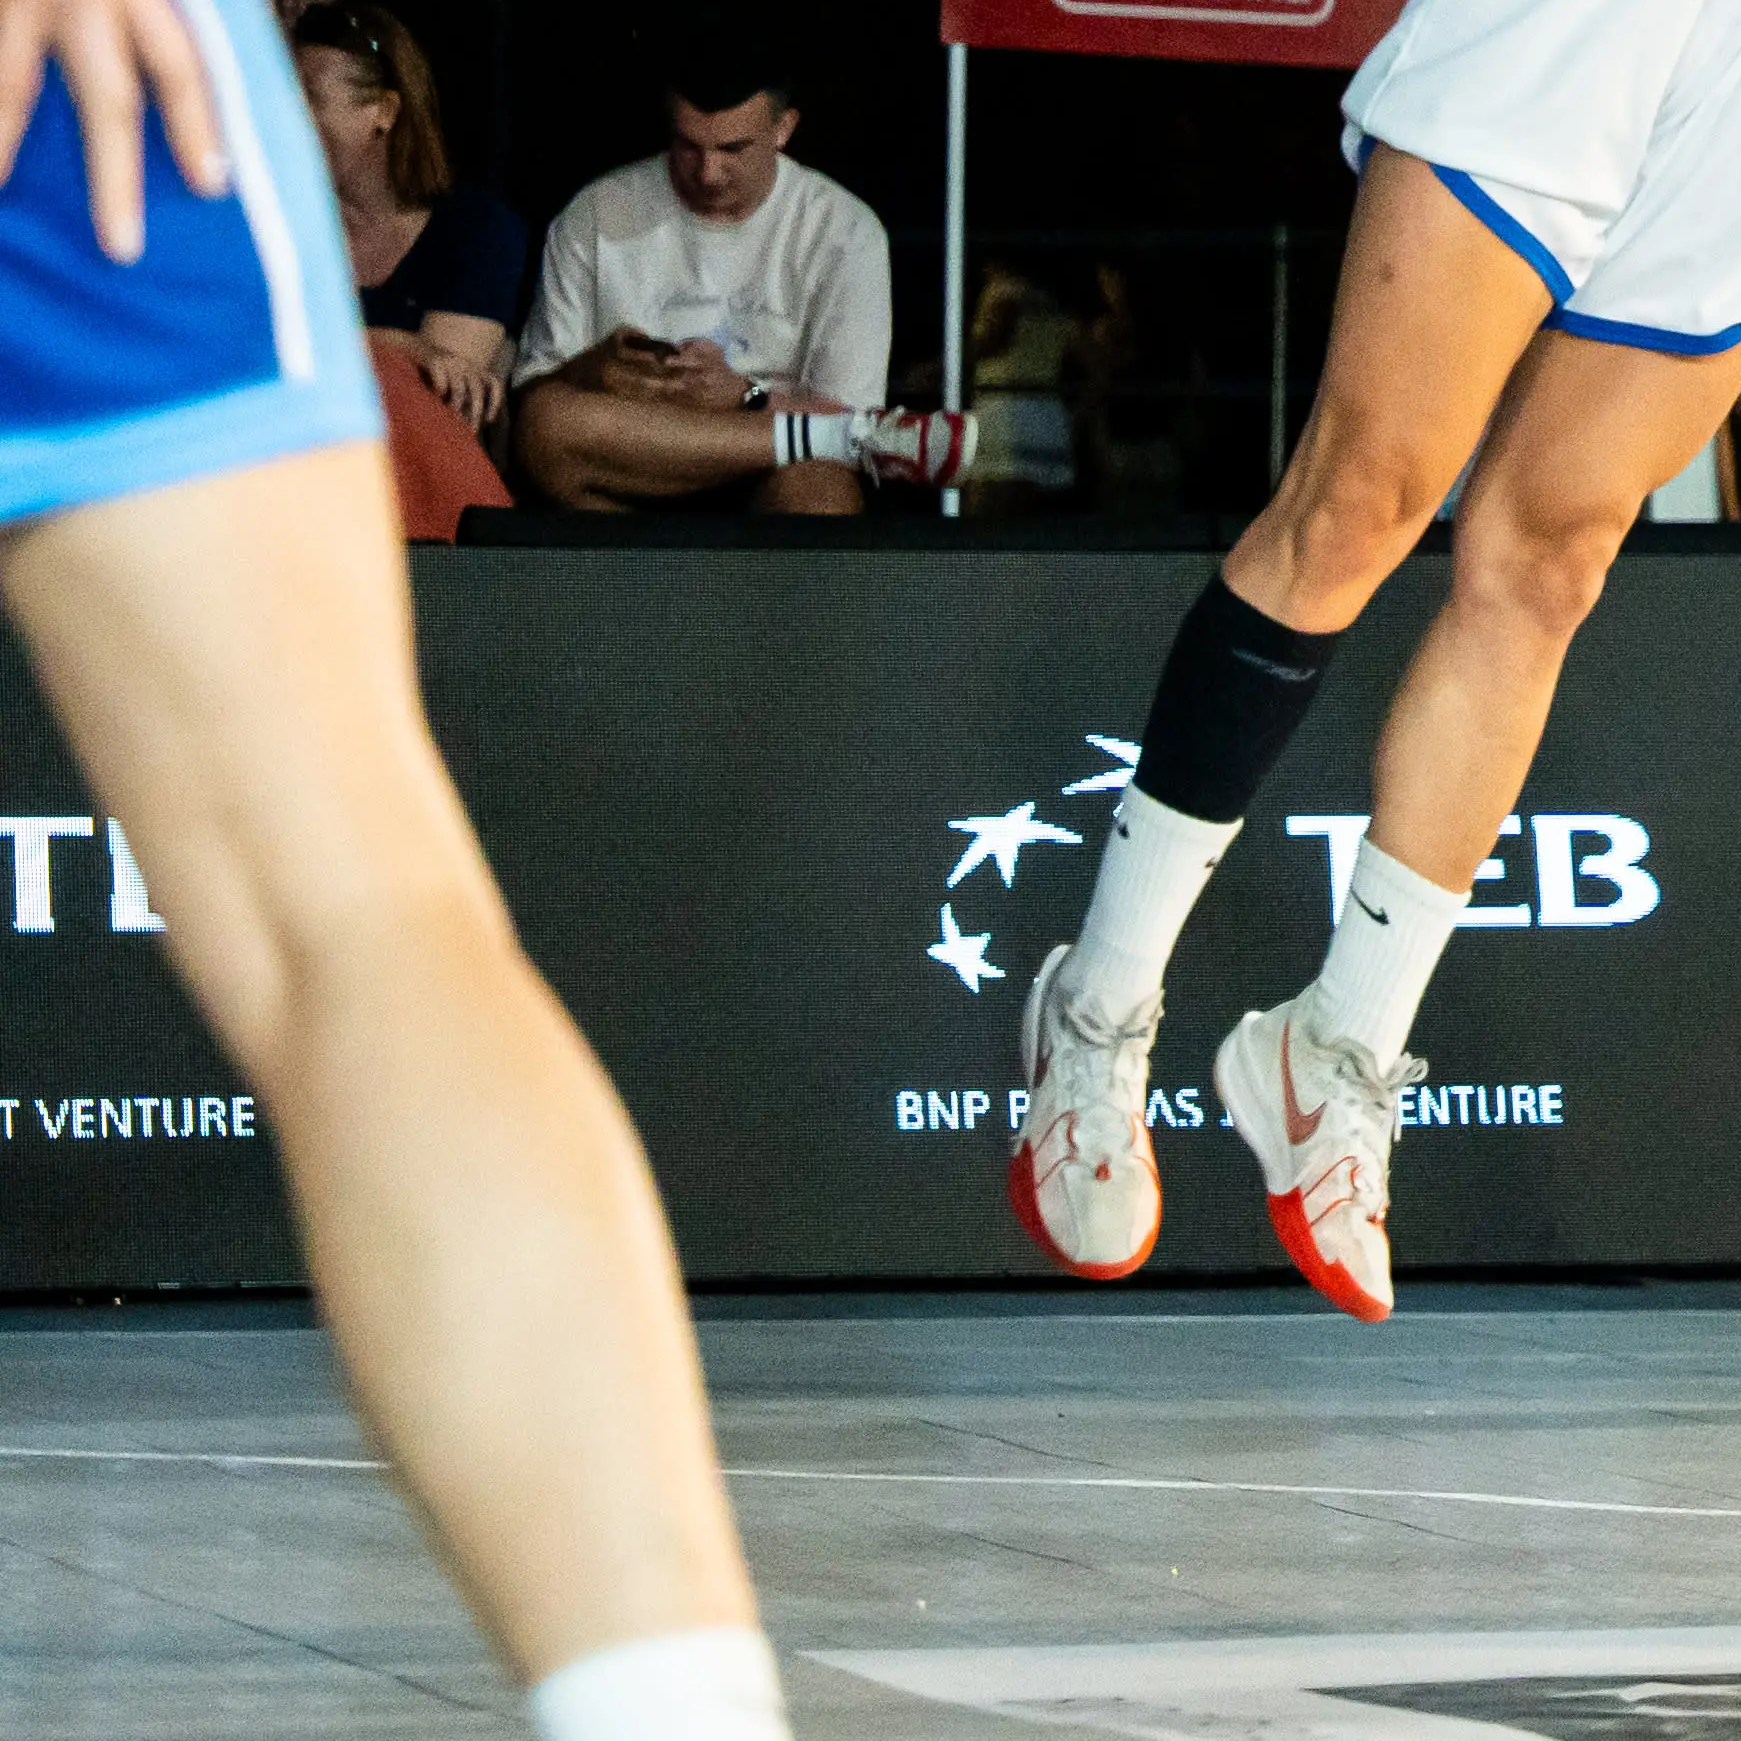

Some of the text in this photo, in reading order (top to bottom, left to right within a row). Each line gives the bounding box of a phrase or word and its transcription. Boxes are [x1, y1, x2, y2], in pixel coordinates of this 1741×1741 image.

[33, 1096, 256, 1139] VENTURE
[896, 1090, 991, 1130] BNP
[1397, 1084, 1563, 1126] ENTURE
